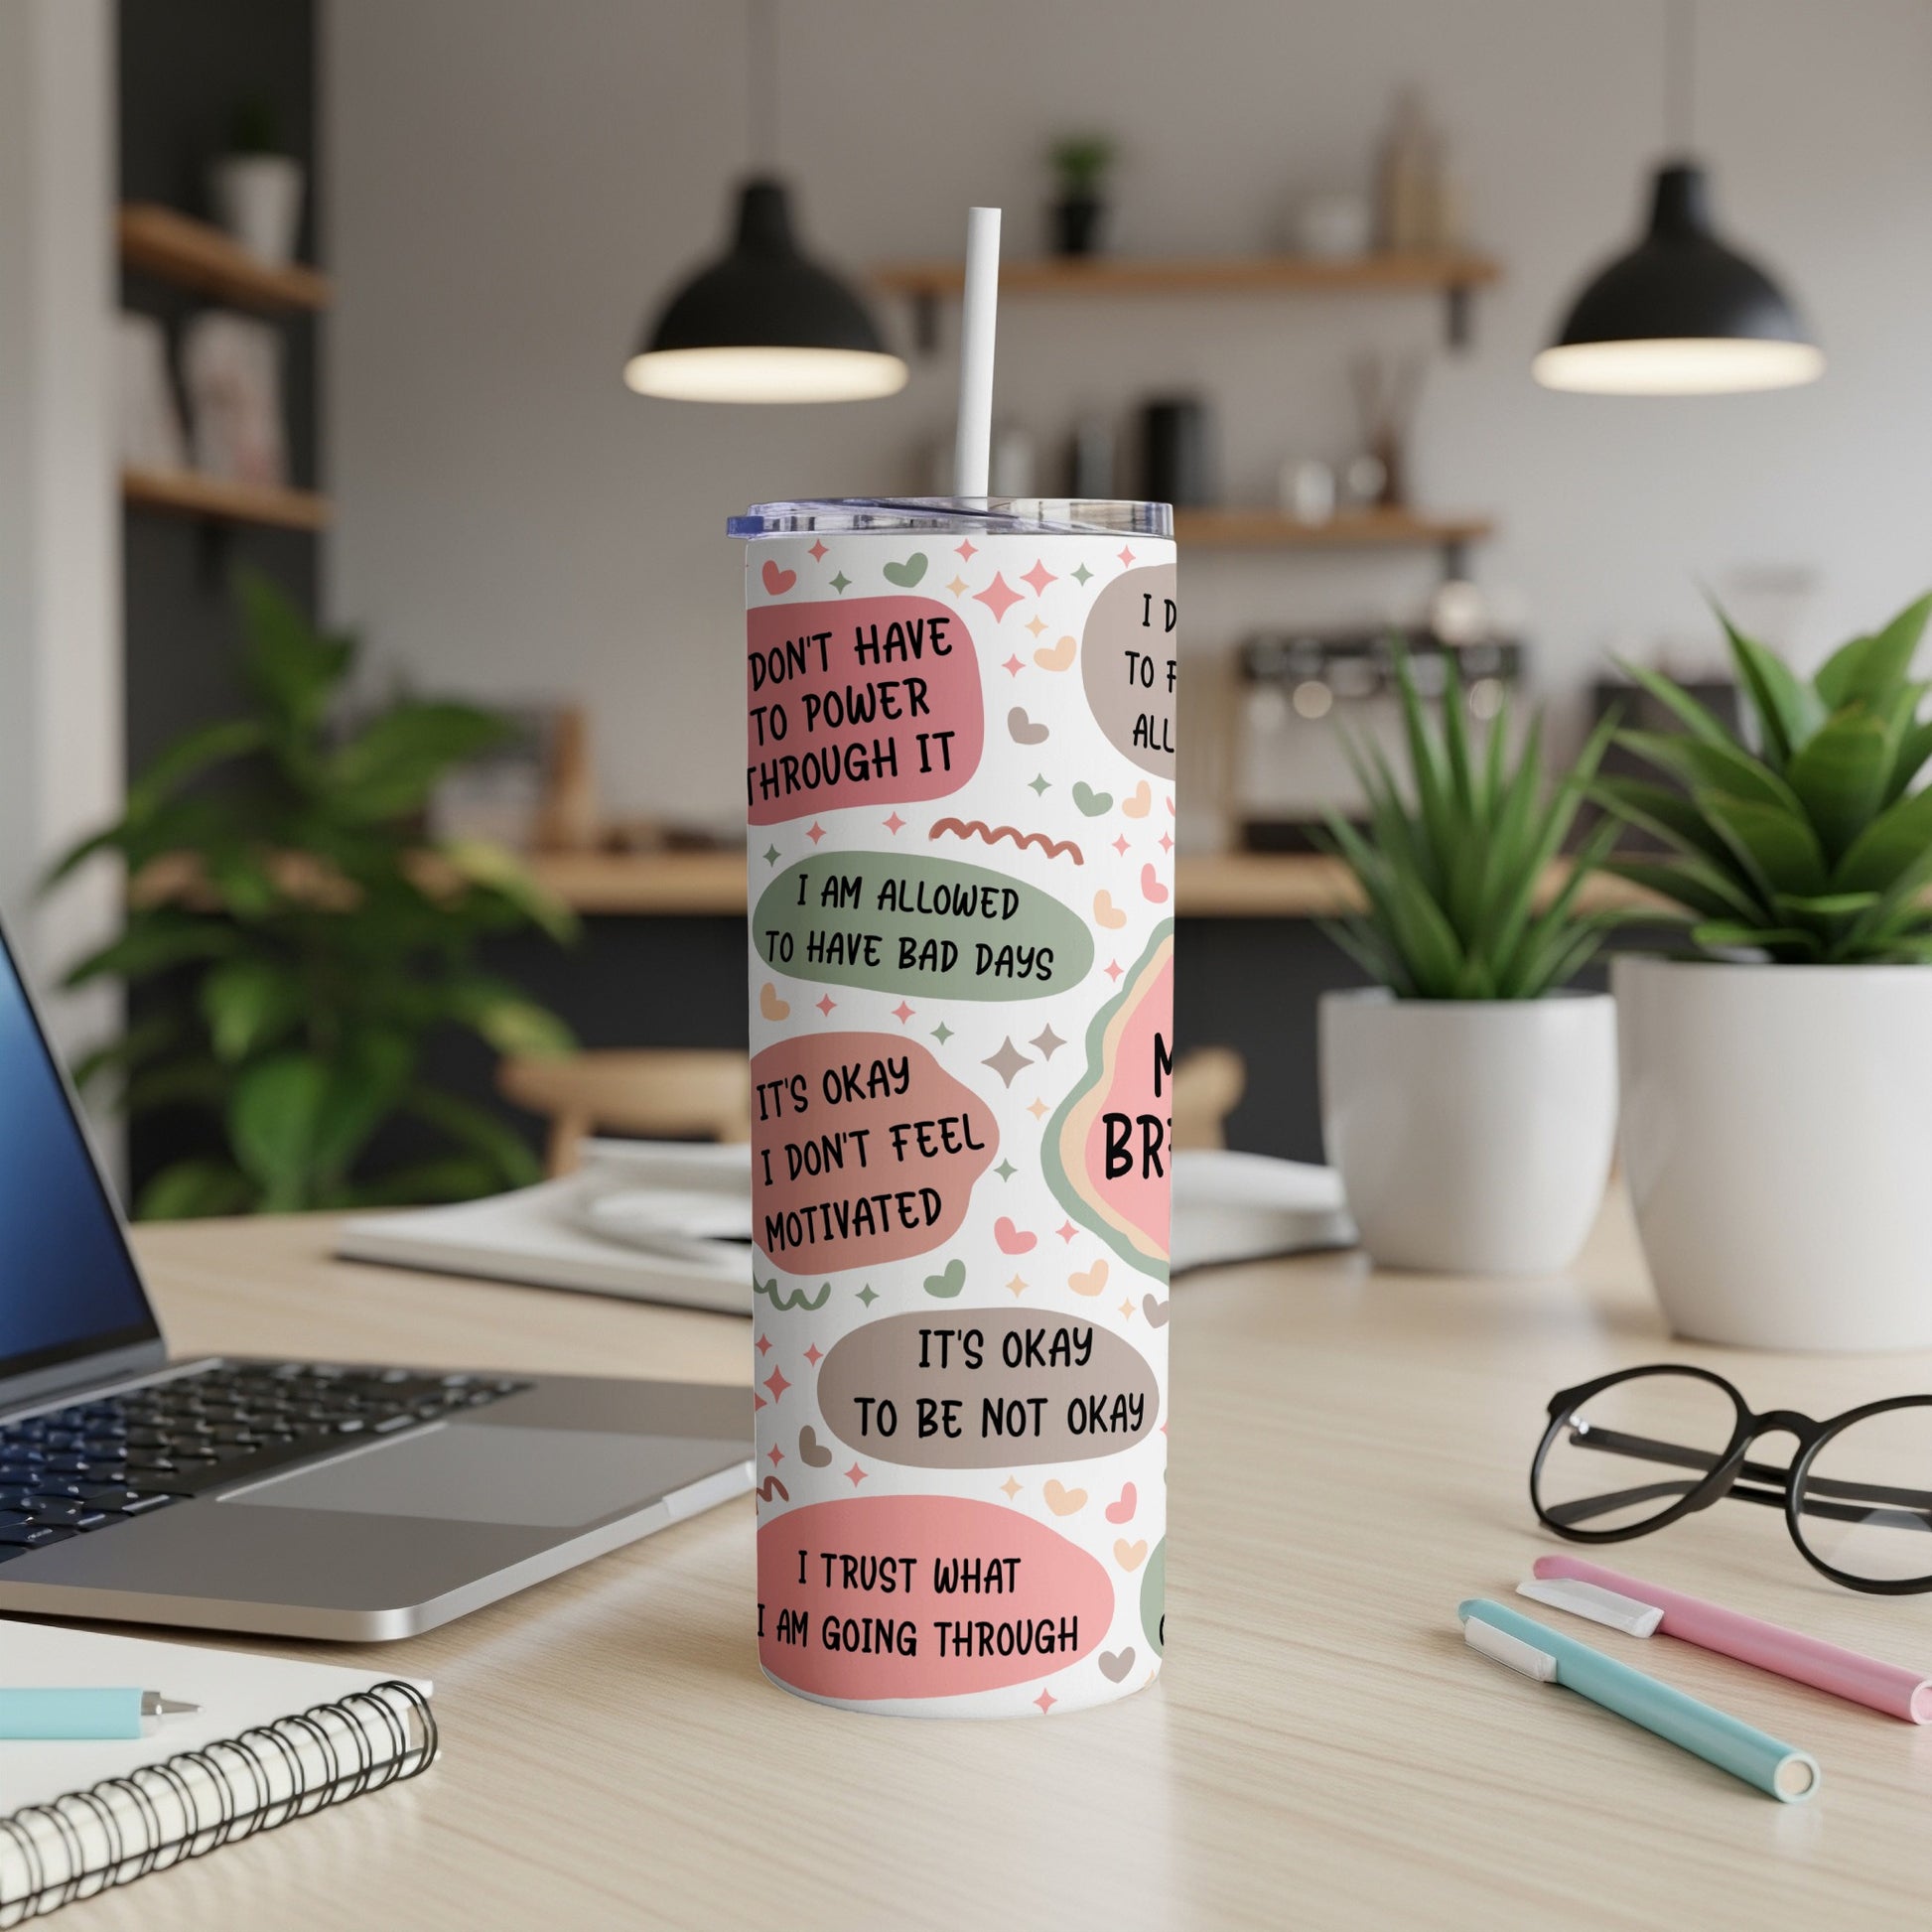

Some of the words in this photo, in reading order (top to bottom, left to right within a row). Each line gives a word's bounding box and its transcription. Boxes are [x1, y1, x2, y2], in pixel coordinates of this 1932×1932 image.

[1142, 593, 1152, 627] I
[748, 631, 833, 692] DON'T
[854, 617, 953, 666] HAVE
[1124, 650, 1155, 688] TO
[749, 703, 788, 747] TO
[801, 677, 930, 733] POWER
[1132, 713, 1174, 754] ALL
[747, 737, 897, 807] THROUGH
[915, 731, 956, 773] IT
[796, 873, 809, 906] I
[820, 875, 863, 910] AM
[877, 879, 1020, 921] ALLOWED
[764, 929, 794, 964] TO
[805, 929, 884, 967] HAVE
[897, 936, 959, 973] BAD
[975, 943, 1055, 981] DAYS
[756, 1074, 809, 1122] IT'S
[822, 1055, 910, 1105] OKAY
[760, 1148, 773, 1186] I
[783, 1129, 871, 1182] DON'T
[889, 1113, 985, 1163] FEEL
[1102, 1112, 1173, 1180] BR
[764, 1187, 942, 1254] MOTIVATED
[918, 1328, 985, 1370] IT'S
[1002, 1326, 1094, 1368] OKAY
[853, 1396, 897, 1438] TO
[915, 1398, 963, 1439] BE
[981, 1396, 1049, 1439] NOT
[1066, 1392, 1145, 1436] OKAY
[798, 1550, 808, 1585] I
[820, 1553, 917, 1593] TRUST
[933, 1557, 1022, 1594] WHAT
[757, 1602, 765, 1638] I
[776, 1608, 809, 1648] AM
[821, 1615, 917, 1657] GOING
[933, 1615, 1079, 1657] THROUGH
